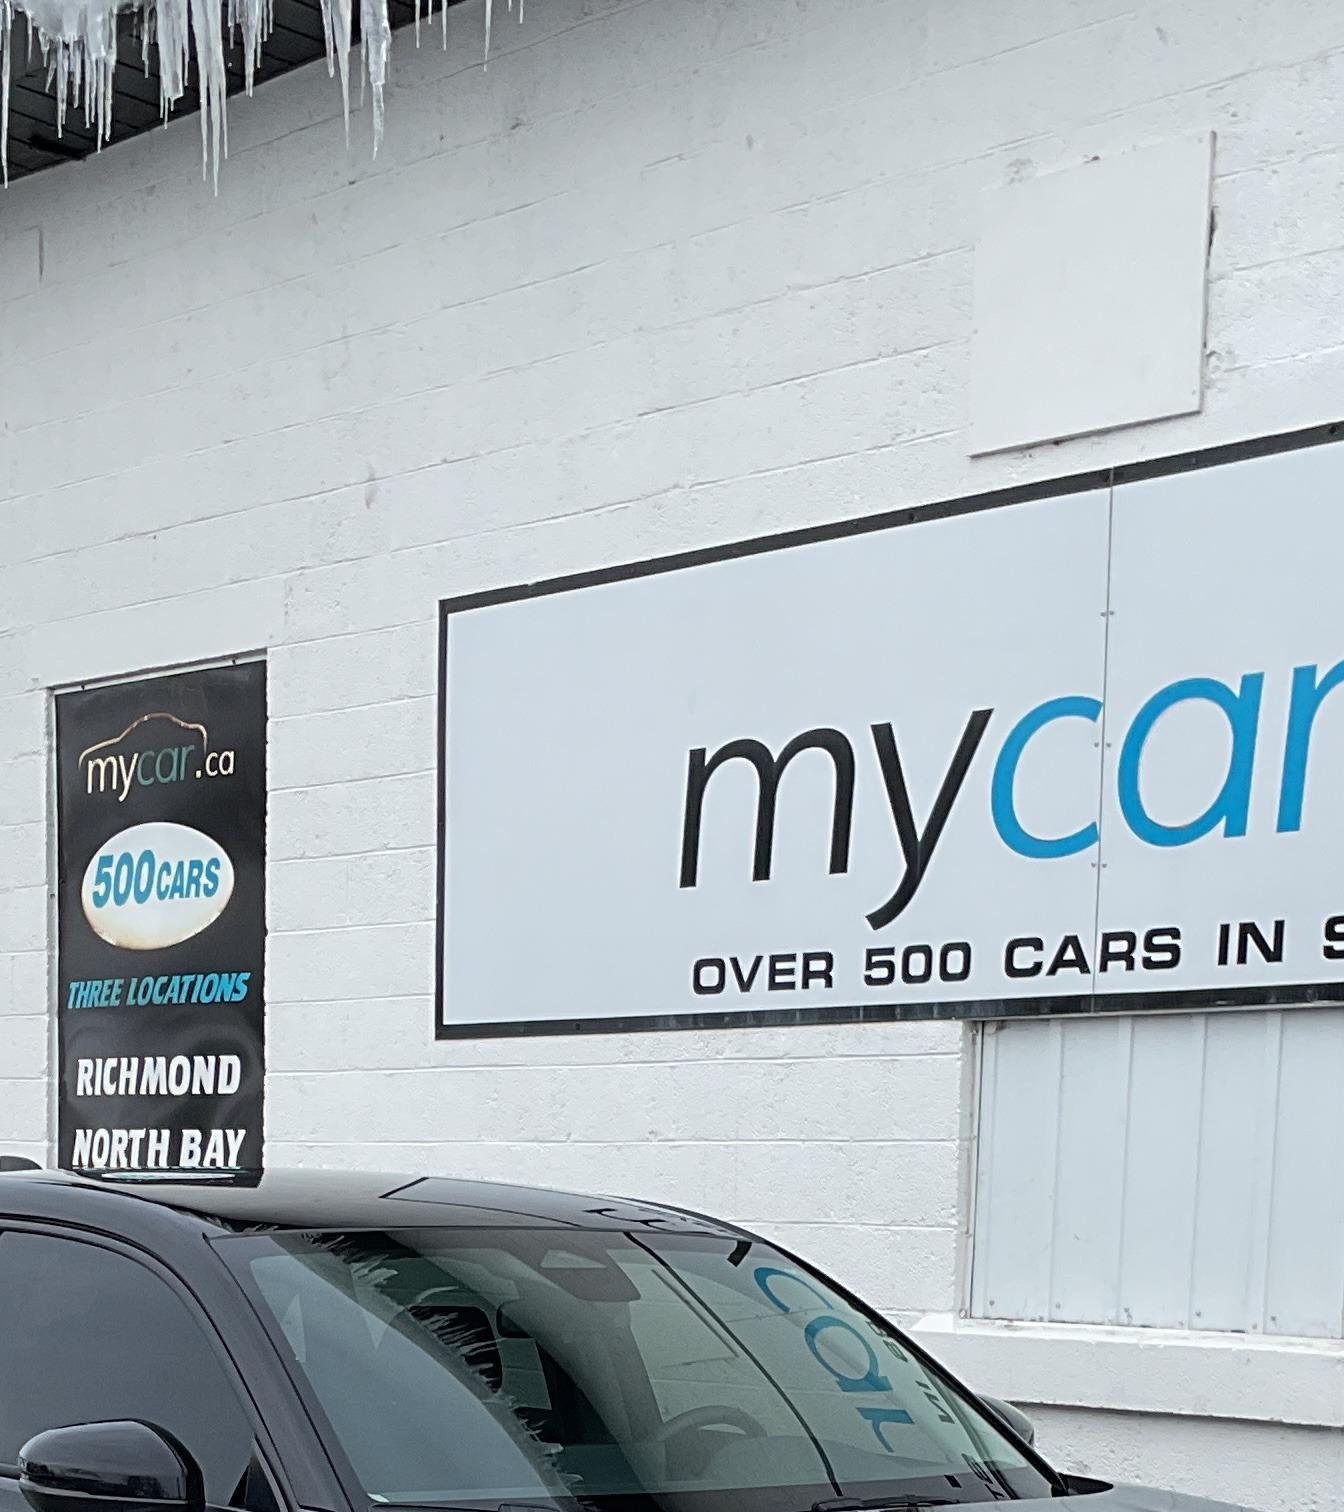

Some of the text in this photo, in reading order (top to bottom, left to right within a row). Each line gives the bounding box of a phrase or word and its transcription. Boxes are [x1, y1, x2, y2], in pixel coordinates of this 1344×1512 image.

[86, 744, 236, 803] mycar.ca
[692, 950, 835, 996] OVER
[863, 940, 973, 987] 500
[1003, 926, 1182, 979] CARS
[1216, 918, 1286, 967] IN
[66, 971, 253, 1010] THREE LOCATIONS
[75, 1054, 242, 1097] RICHMOND
[71, 1127, 247, 1170] NORTH BAY
